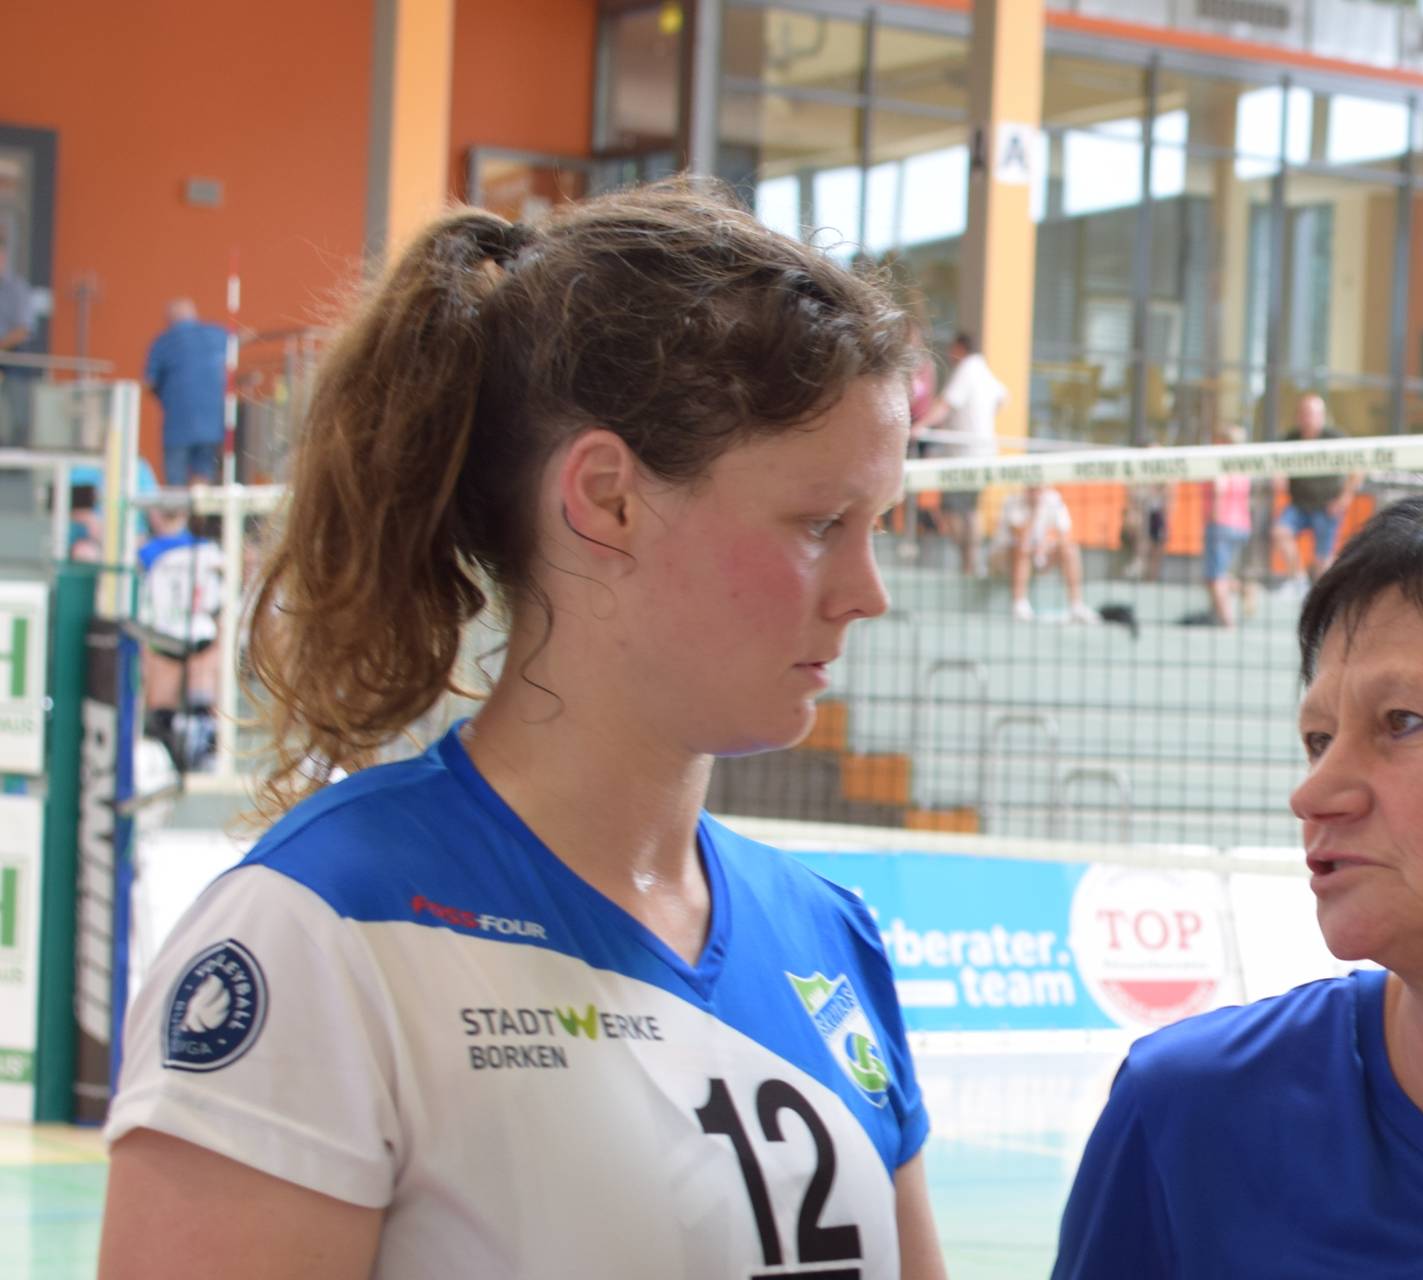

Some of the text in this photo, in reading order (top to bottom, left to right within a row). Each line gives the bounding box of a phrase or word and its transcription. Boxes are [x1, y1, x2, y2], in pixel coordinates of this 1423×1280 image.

[1094, 908, 1203, 951] TOP
[958, 964, 1076, 1007] team
[461, 1003, 665, 1041] STADTWERKE
[469, 1046, 569, 1070] BORKEN
[694, 1078, 862, 1267] 12
